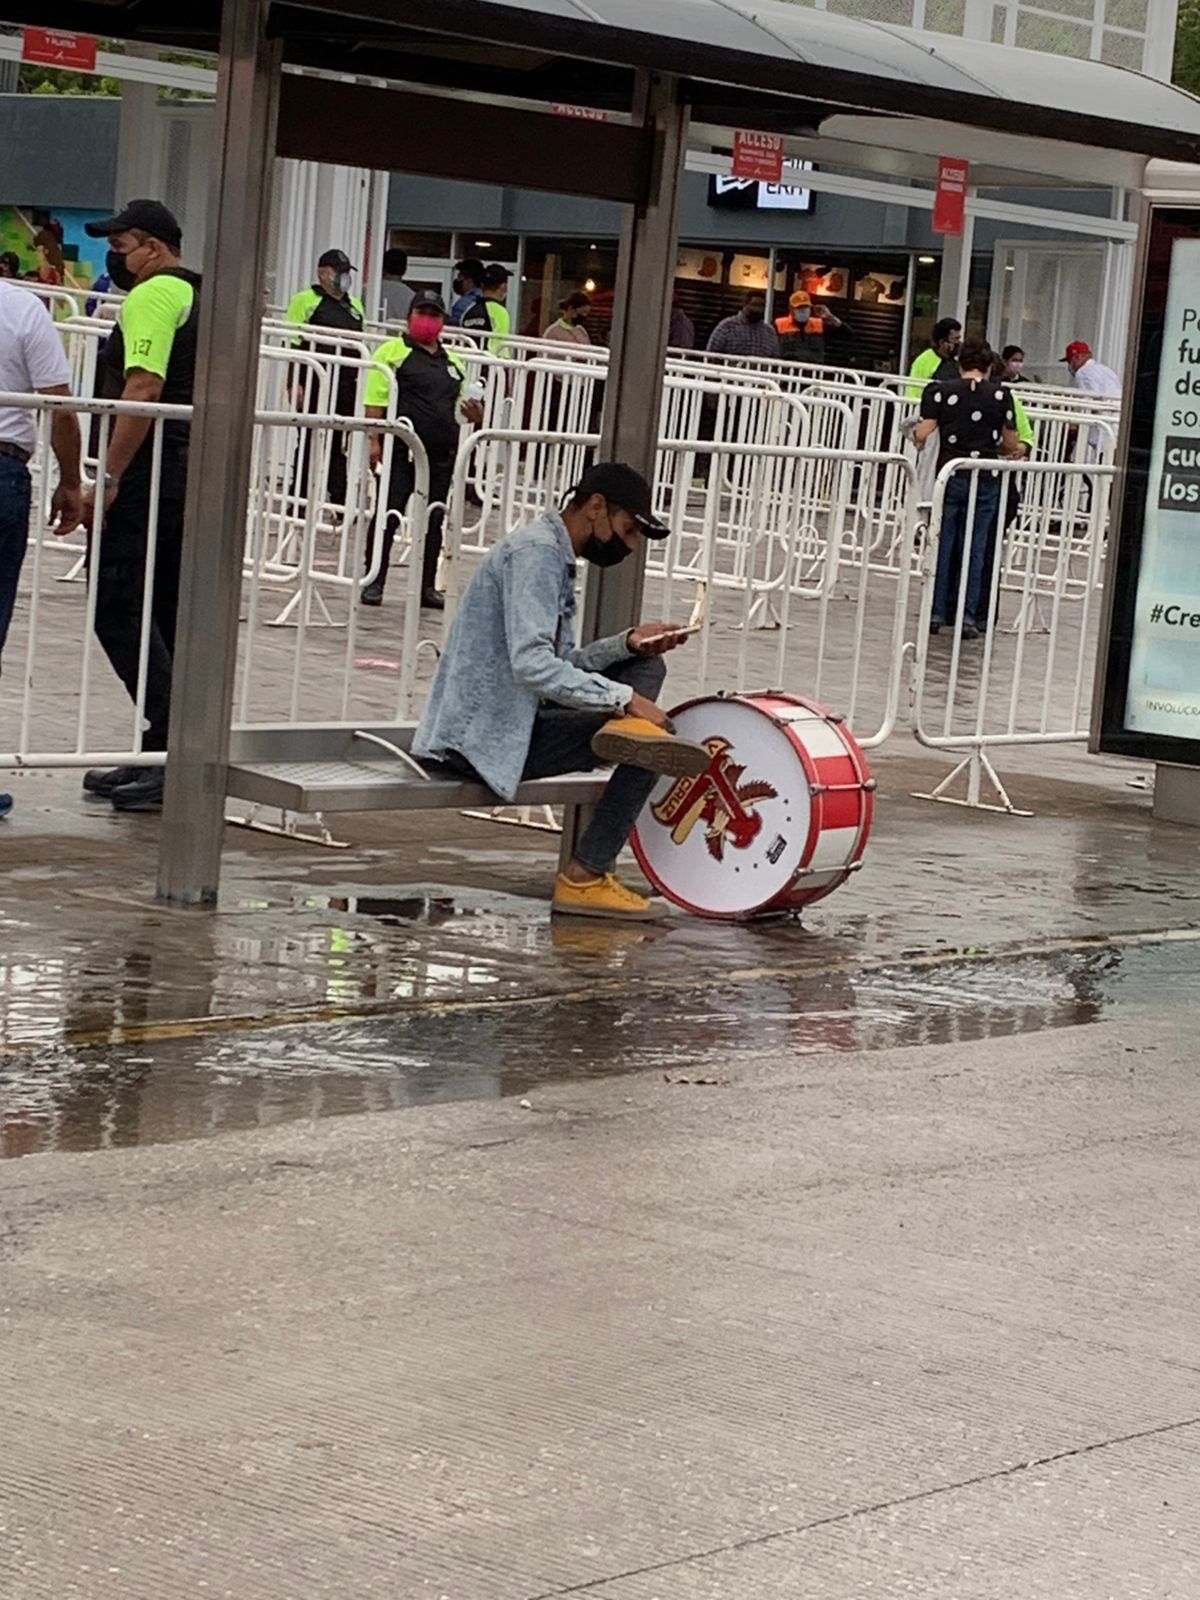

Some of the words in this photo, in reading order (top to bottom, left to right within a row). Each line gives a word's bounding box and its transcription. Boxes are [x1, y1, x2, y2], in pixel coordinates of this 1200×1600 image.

[1182, 308, 1200, 332] P
[132, 339, 152, 357] 127
[1171, 410, 1200, 428] so
[1163, 473, 1200, 503] los
[1146, 700, 1200, 717] INVOLUCR
